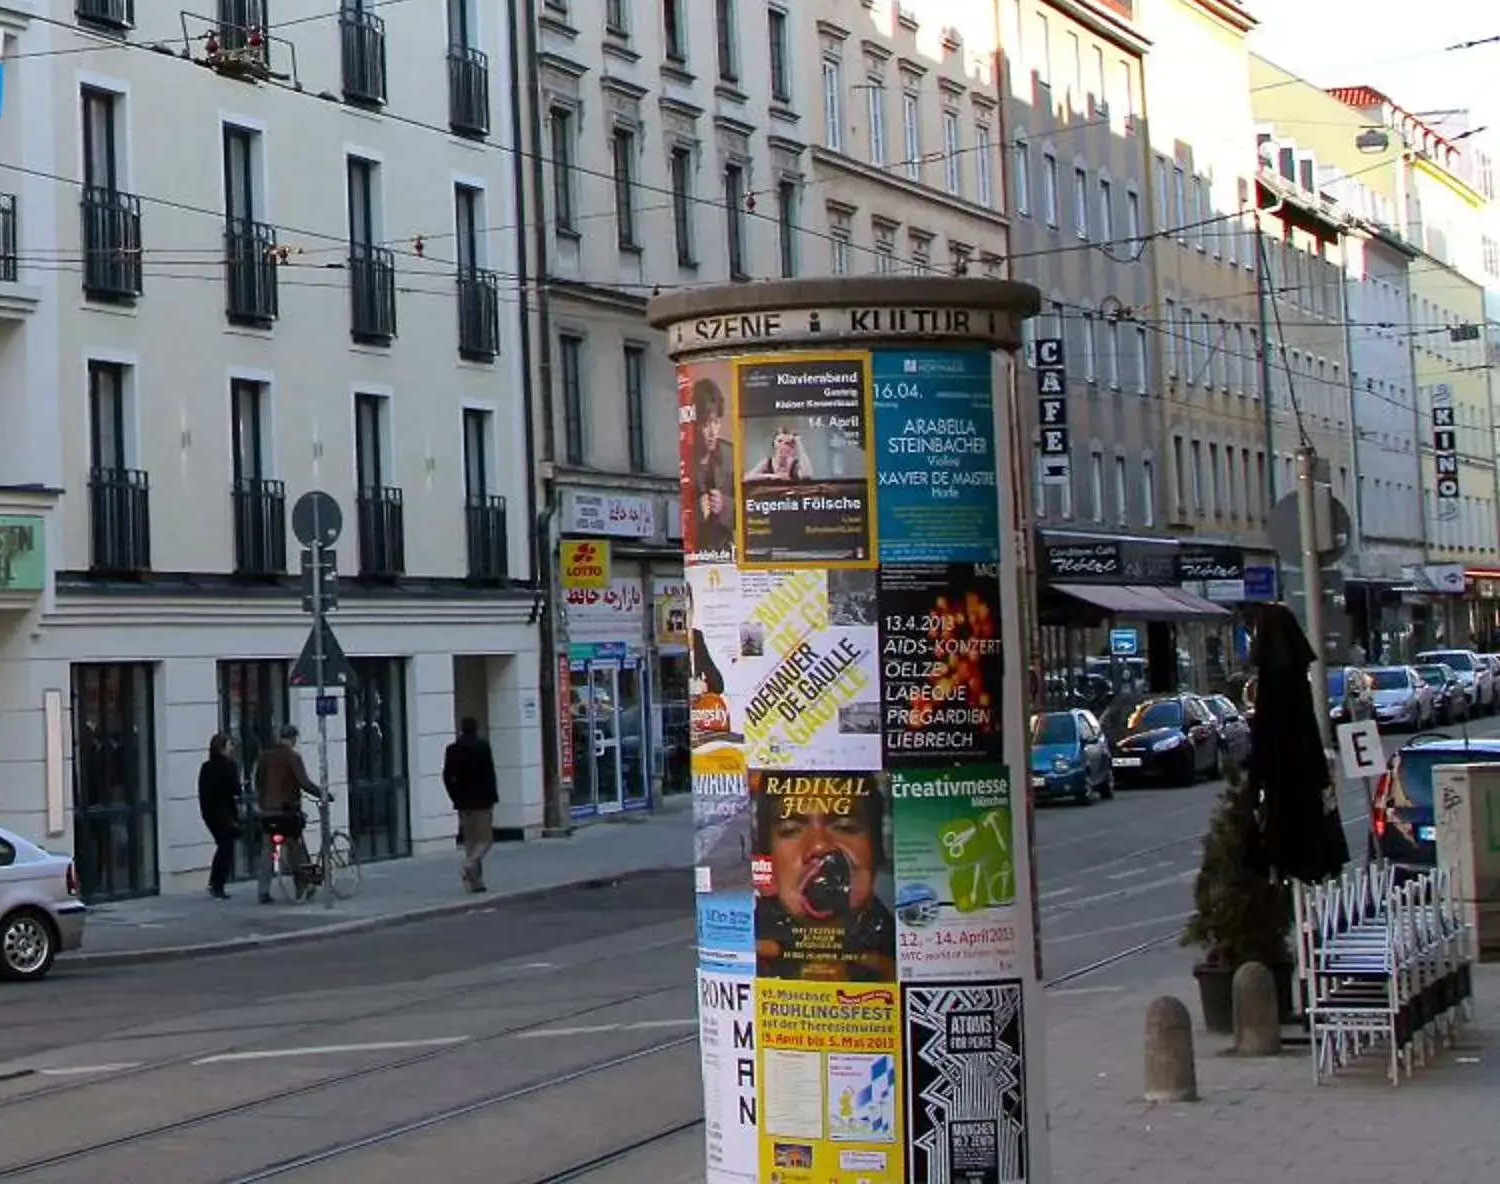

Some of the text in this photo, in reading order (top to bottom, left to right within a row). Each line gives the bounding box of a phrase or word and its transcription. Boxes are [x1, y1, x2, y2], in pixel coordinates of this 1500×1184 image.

[873, 382, 923, 399] 16.04.
[1041, 341, 1063, 452] CAFE
[903, 418, 976, 435] ARABELLA
[1436, 409, 1457, 495] KINO
[878, 471, 929, 485] XAVIER
[931, 471, 949, 485] DE
[567, 567, 602, 576] LOTTO
[884, 639, 1001, 655] AIDS-KONZERT
[744, 642, 819, 727] ADENAUER
[777, 637, 861, 722] DE GAULLE
[887, 731, 973, 748] LIEBREICH
[1352, 731, 1373, 768] E
[766, 777, 869, 796] RADIKAL
[892, 776, 1008, 797] creativmesse
[780, 796, 851, 819] JUNG
[935, 931, 957, 945] 14.
[960, 928, 989, 948] April
